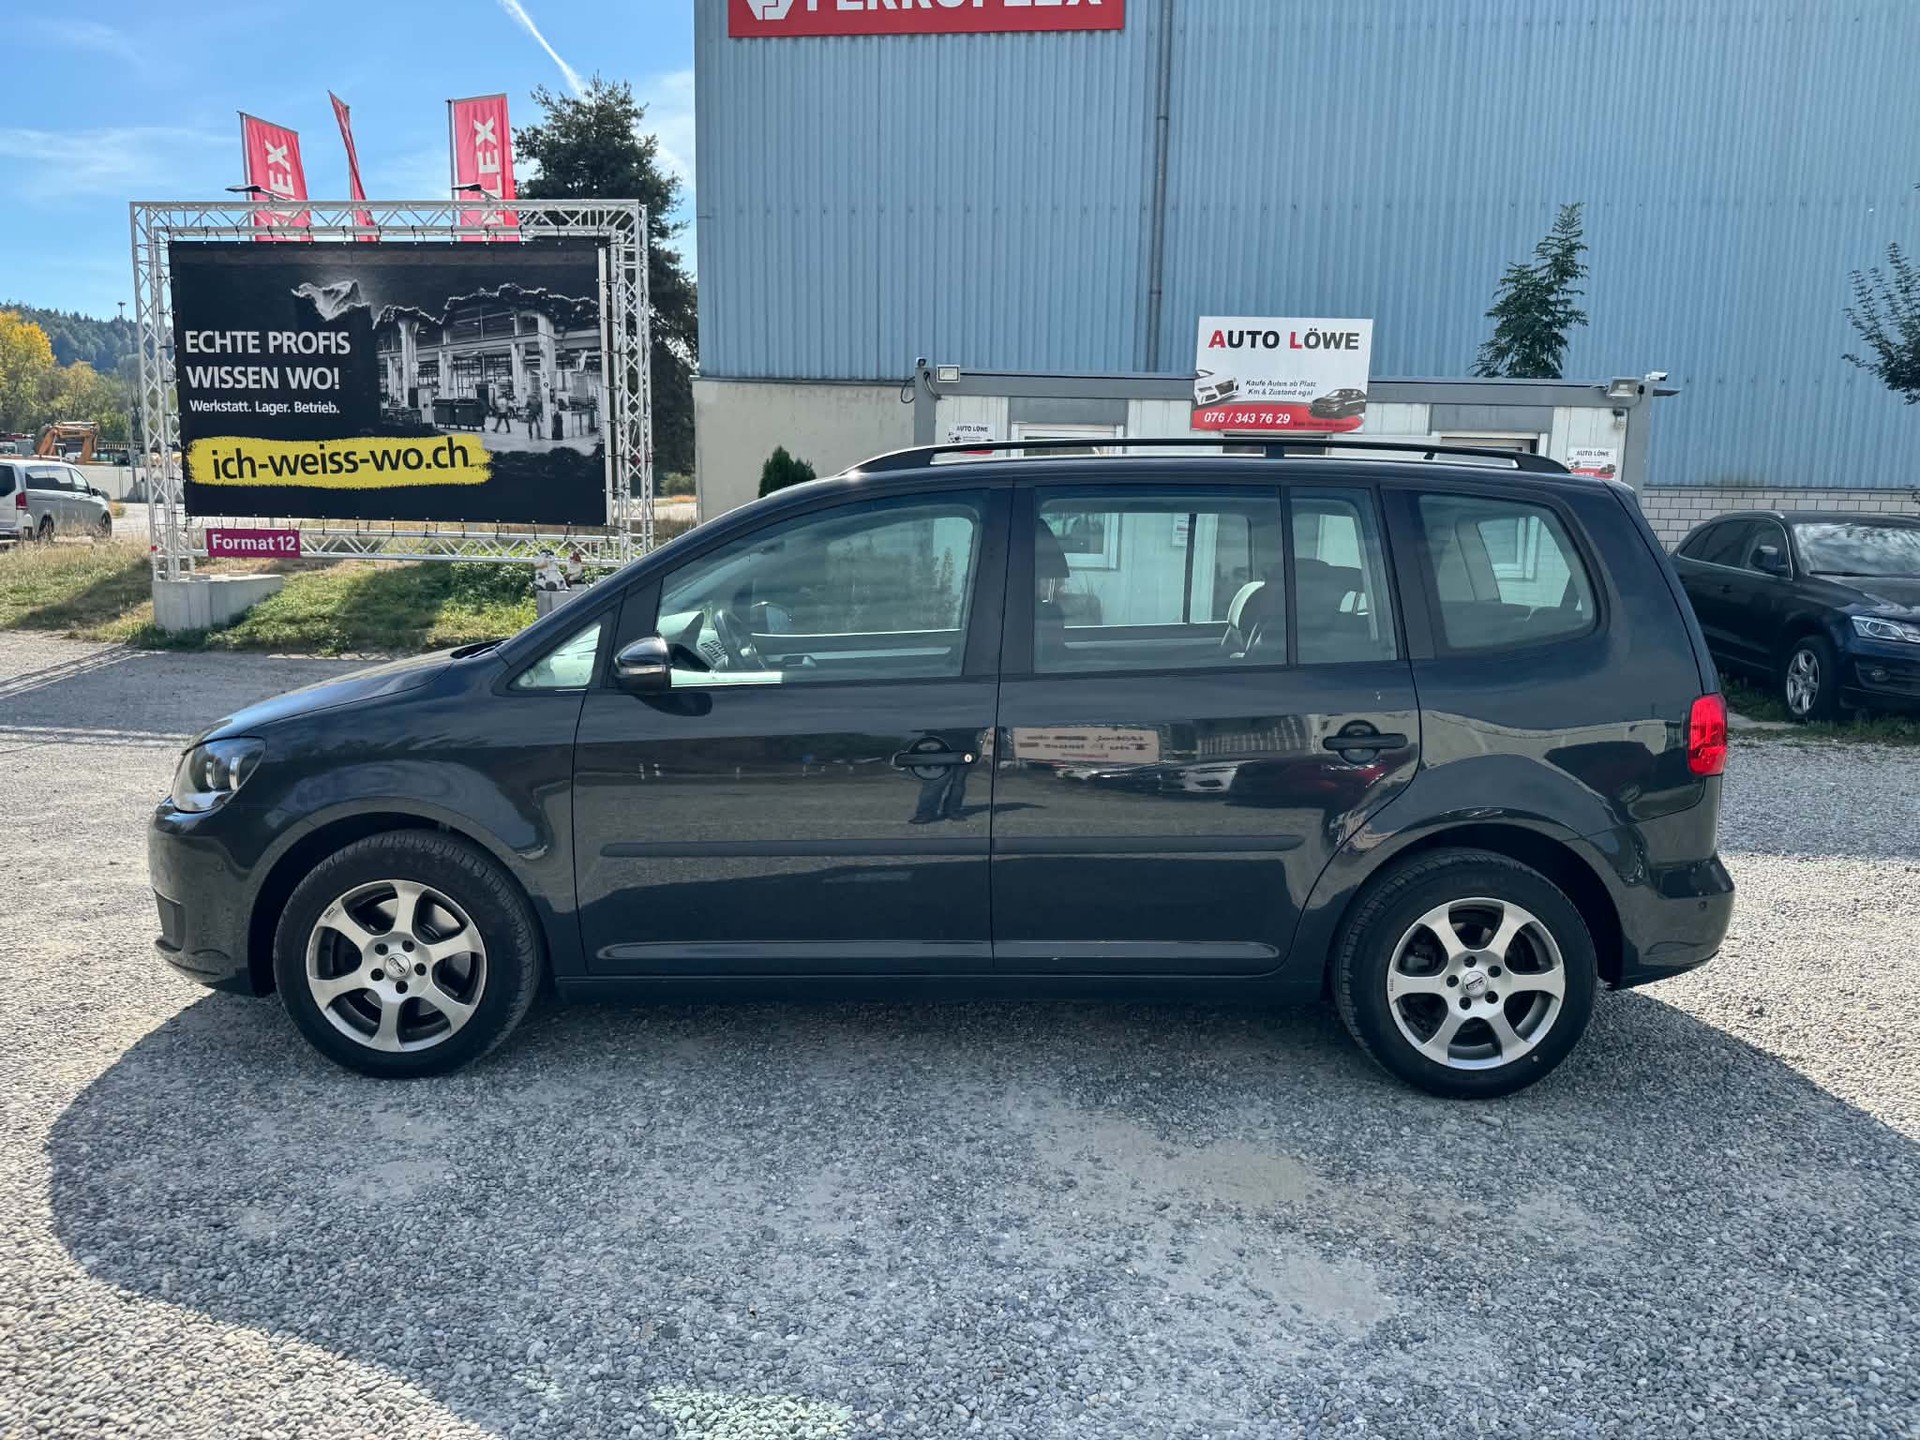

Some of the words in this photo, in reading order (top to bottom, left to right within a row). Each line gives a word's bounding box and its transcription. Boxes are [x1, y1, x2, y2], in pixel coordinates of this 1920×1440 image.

[185, 330, 261, 353] ECHTE
[267, 331, 351, 354] PROFIS
[1208, 329, 1280, 349] AUTO
[1289, 327, 1360, 350] LÖWE
[185, 365, 279, 389] WISSEN
[285, 367, 340, 390] WO!
[189, 400, 252, 412] Werkstatt.
[255, 401, 291, 415] Lager.
[294, 401, 340, 414] Betrieb.
[1204, 412, 1225, 423] 076
[1234, 413, 1256, 424] 343
[1259, 413, 1273, 424] 76
[1276, 413, 1291, 424] 29
[212, 437, 470, 479] ich-weiss-wo.ch
[212, 534, 275, 551] Format
[276, 535, 296, 551] 12
